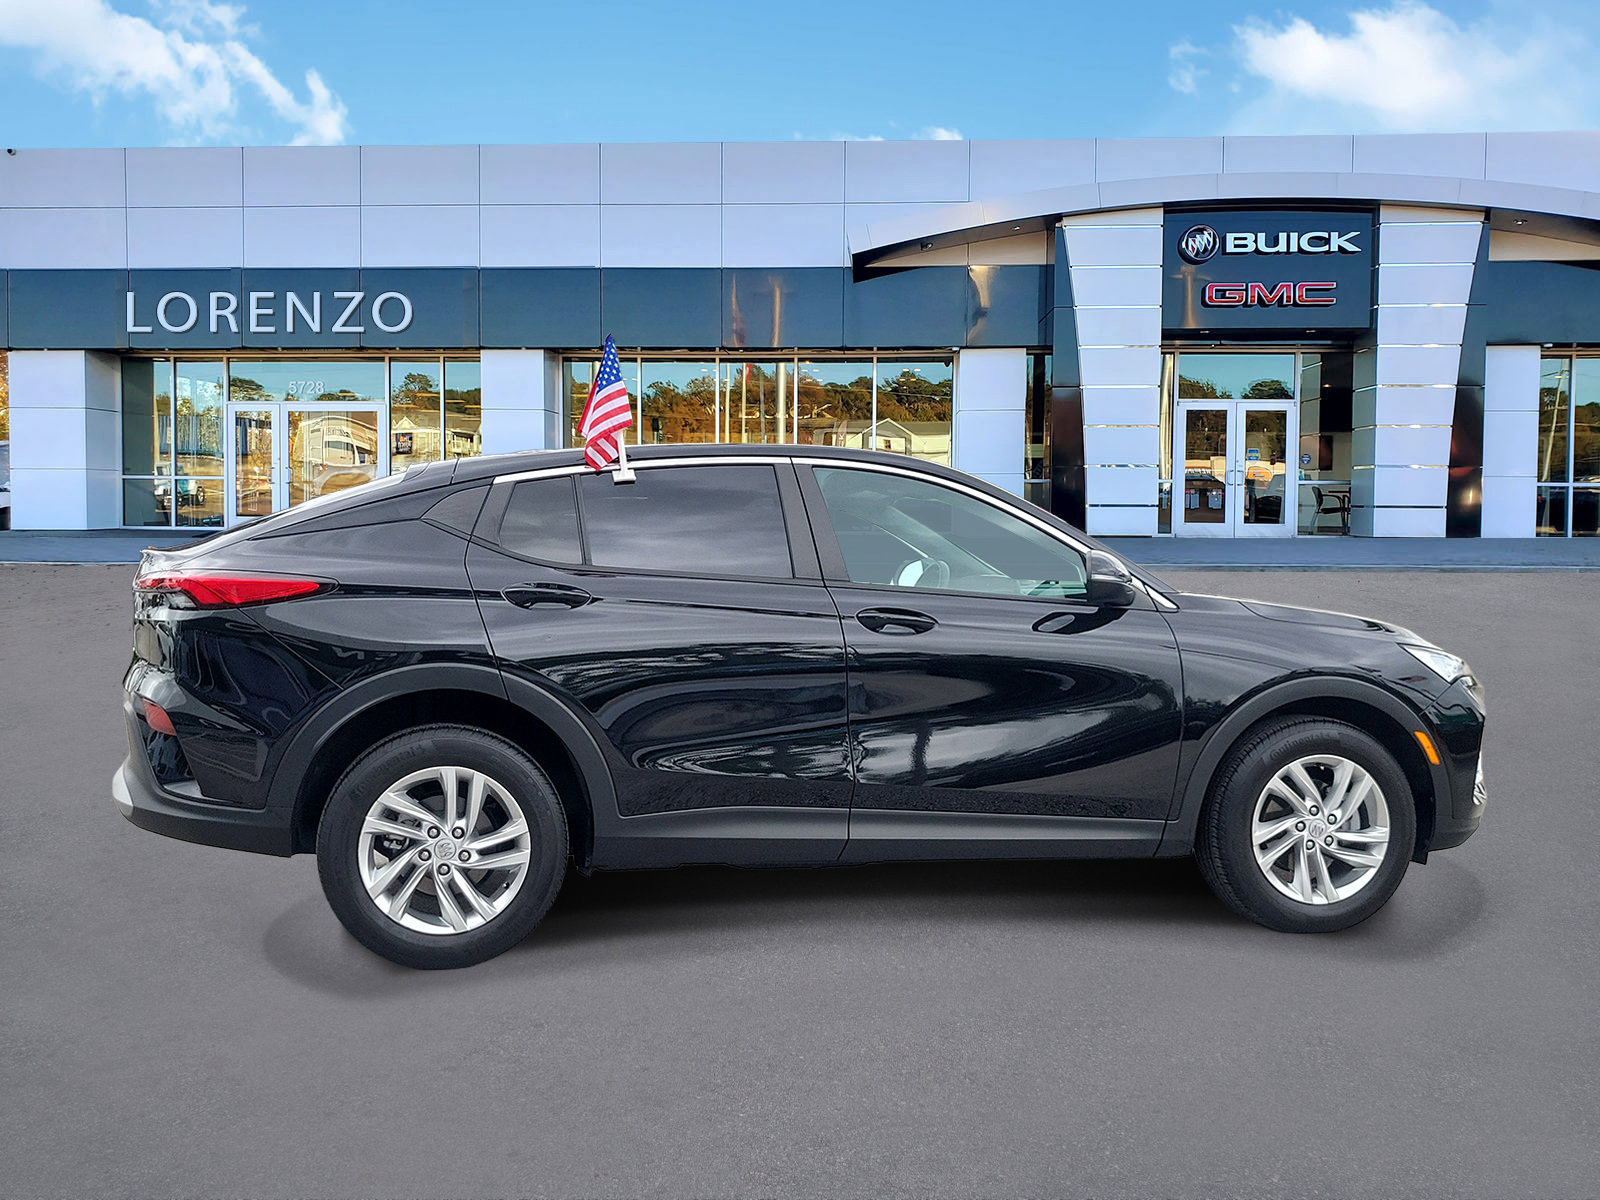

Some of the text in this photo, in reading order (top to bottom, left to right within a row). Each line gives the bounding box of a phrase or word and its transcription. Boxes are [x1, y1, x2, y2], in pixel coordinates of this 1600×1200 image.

[1225, 231, 1362, 253] BUICK
[1205, 281, 1336, 305] GMC
[126, 291, 413, 333] LORENZO
[288, 380, 325, 394] 5728
